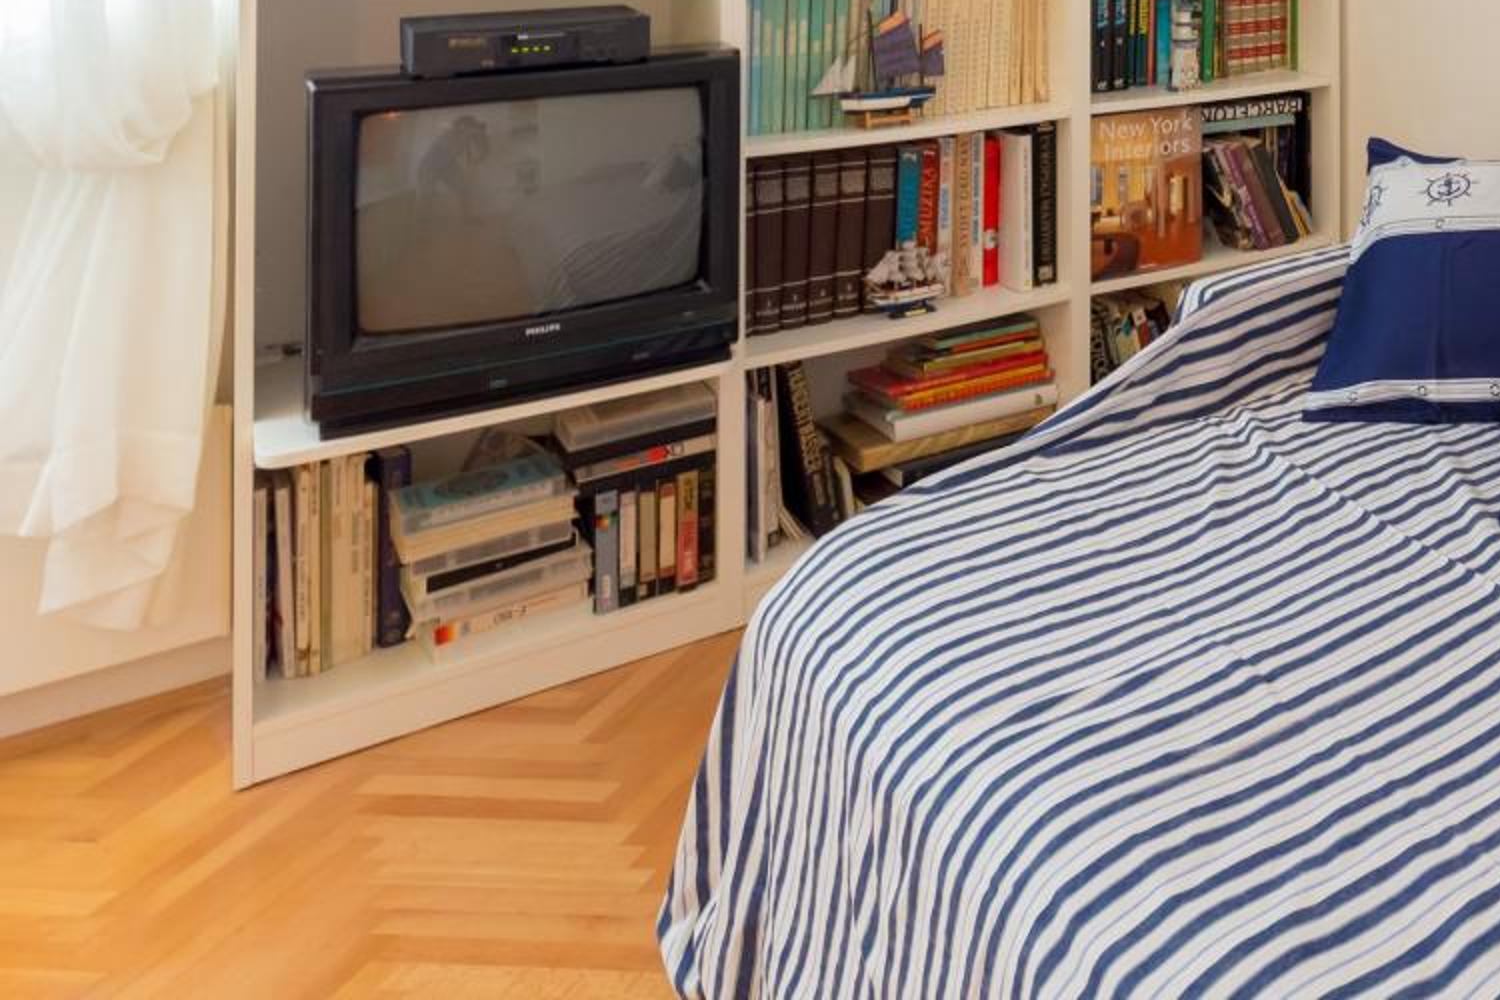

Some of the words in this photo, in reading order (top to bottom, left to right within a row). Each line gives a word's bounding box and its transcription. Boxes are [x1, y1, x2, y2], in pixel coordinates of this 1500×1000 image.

[1201, 97, 1304, 121] BARCELON
[1099, 120, 1145, 138] New
[1151, 110, 1193, 135] York
